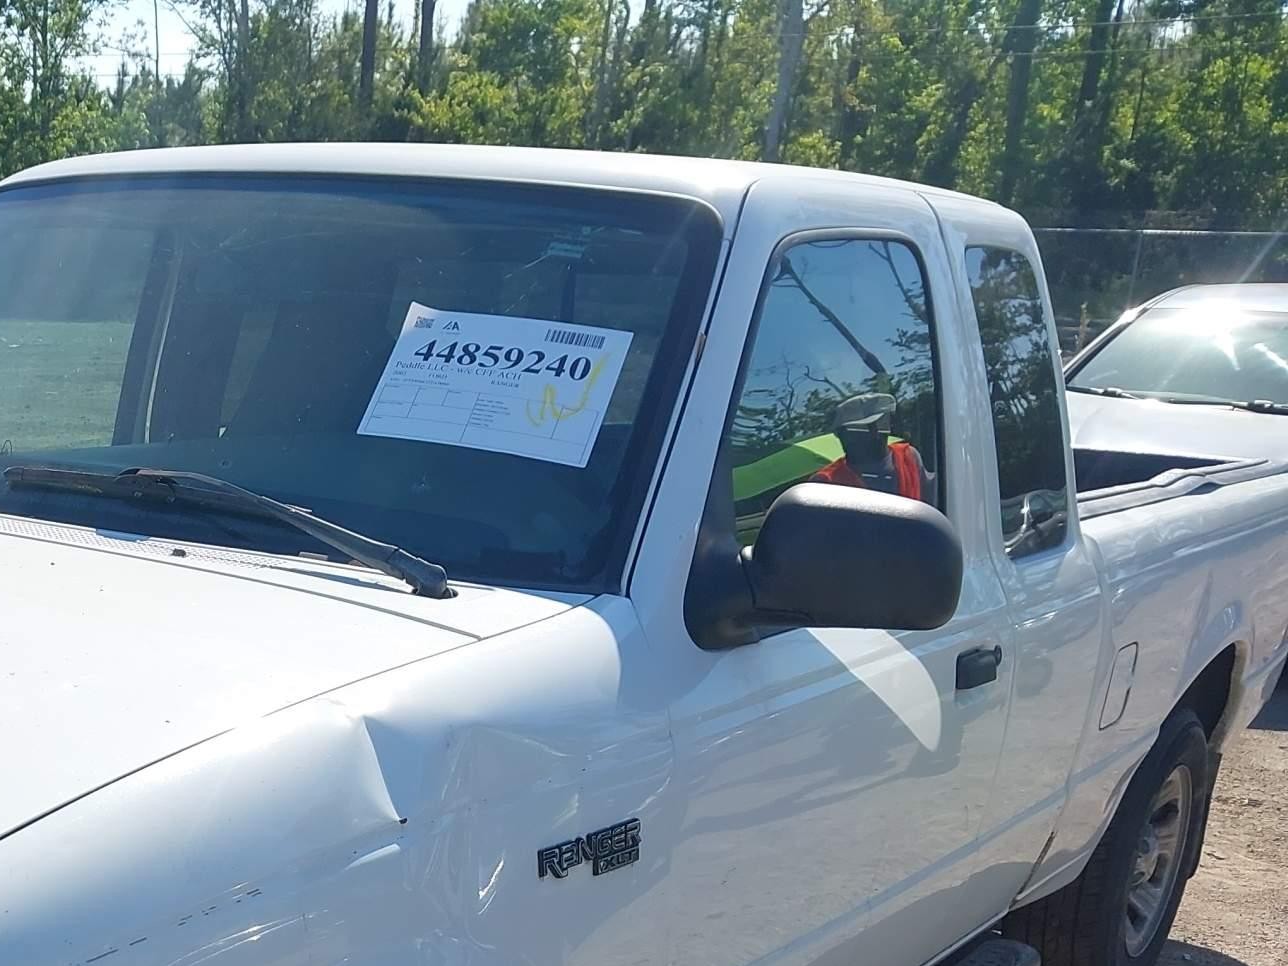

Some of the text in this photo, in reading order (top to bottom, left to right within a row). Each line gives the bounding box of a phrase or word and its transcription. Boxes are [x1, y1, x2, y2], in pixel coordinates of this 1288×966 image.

[395, 361, 425, 370] Peddle
[427, 363, 449, 372] LLC
[497, 371, 522, 380] ACH
[414, 339, 592, 381] 44859240
[537, 818, 642, 879] RANGER
[597, 848, 639, 873] XLT
